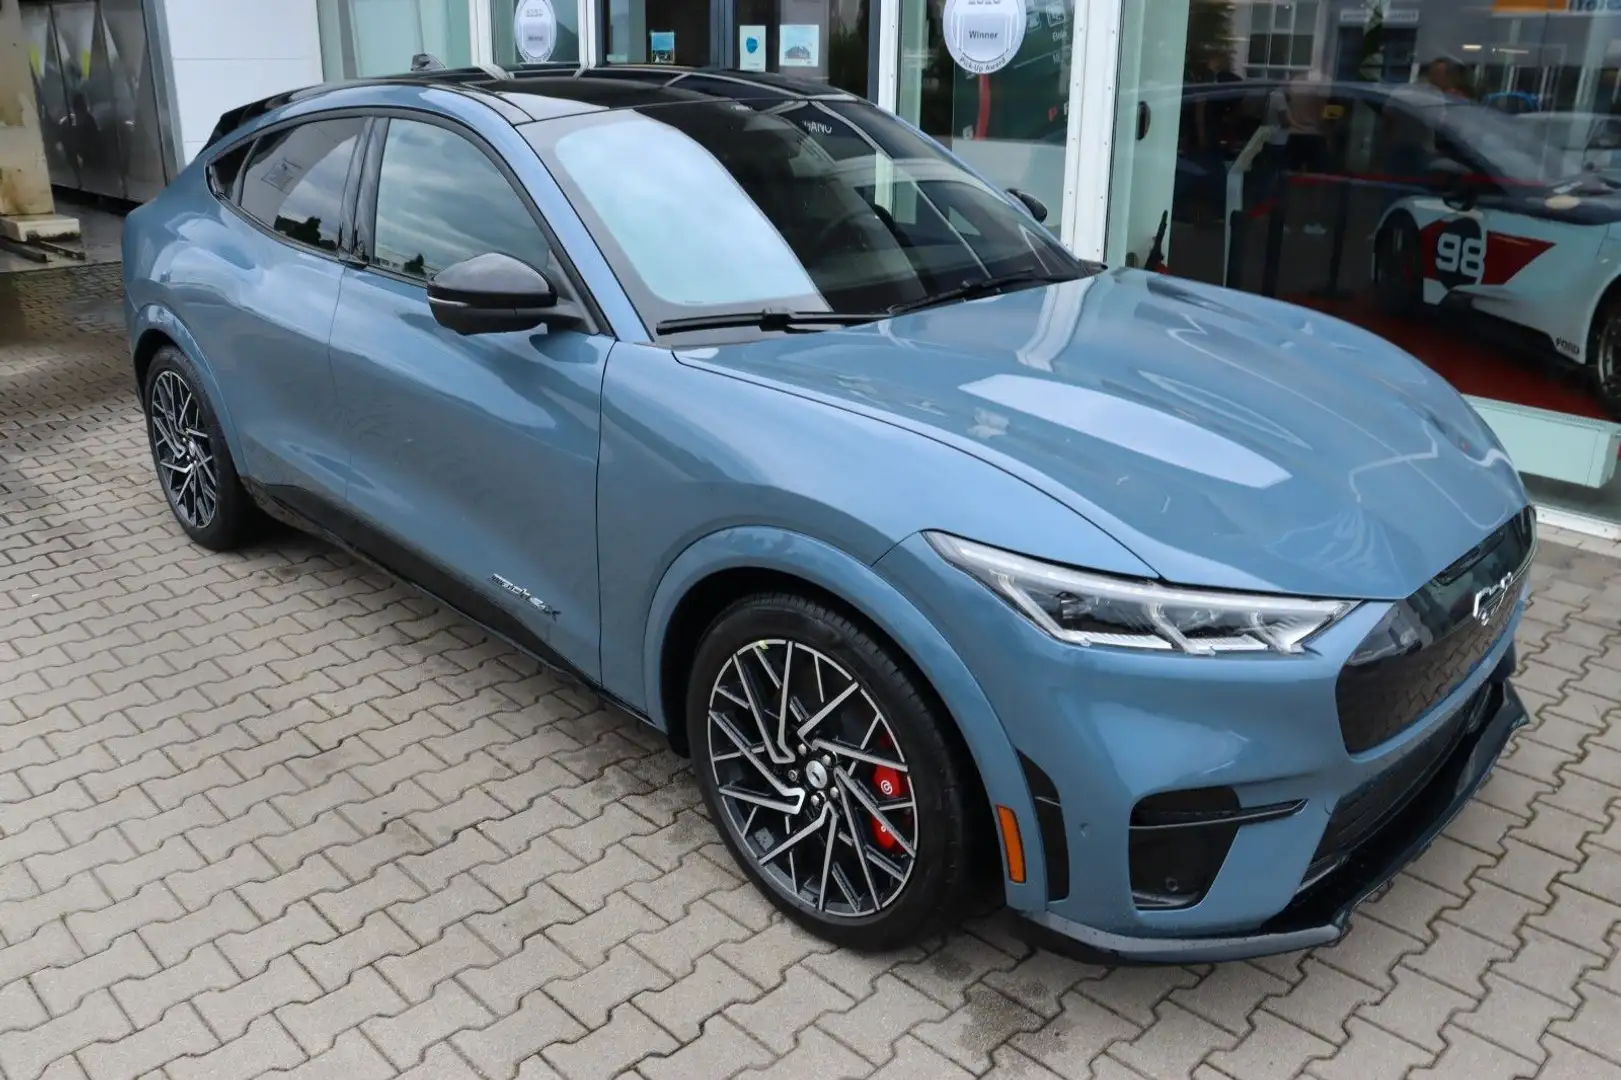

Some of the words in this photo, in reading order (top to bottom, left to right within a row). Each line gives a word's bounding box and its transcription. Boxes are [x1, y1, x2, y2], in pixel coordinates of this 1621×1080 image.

[969, 31, 998, 39] Winner
[985, 57, 1005, 70] Award
[1435, 232, 1485, 278] 98
